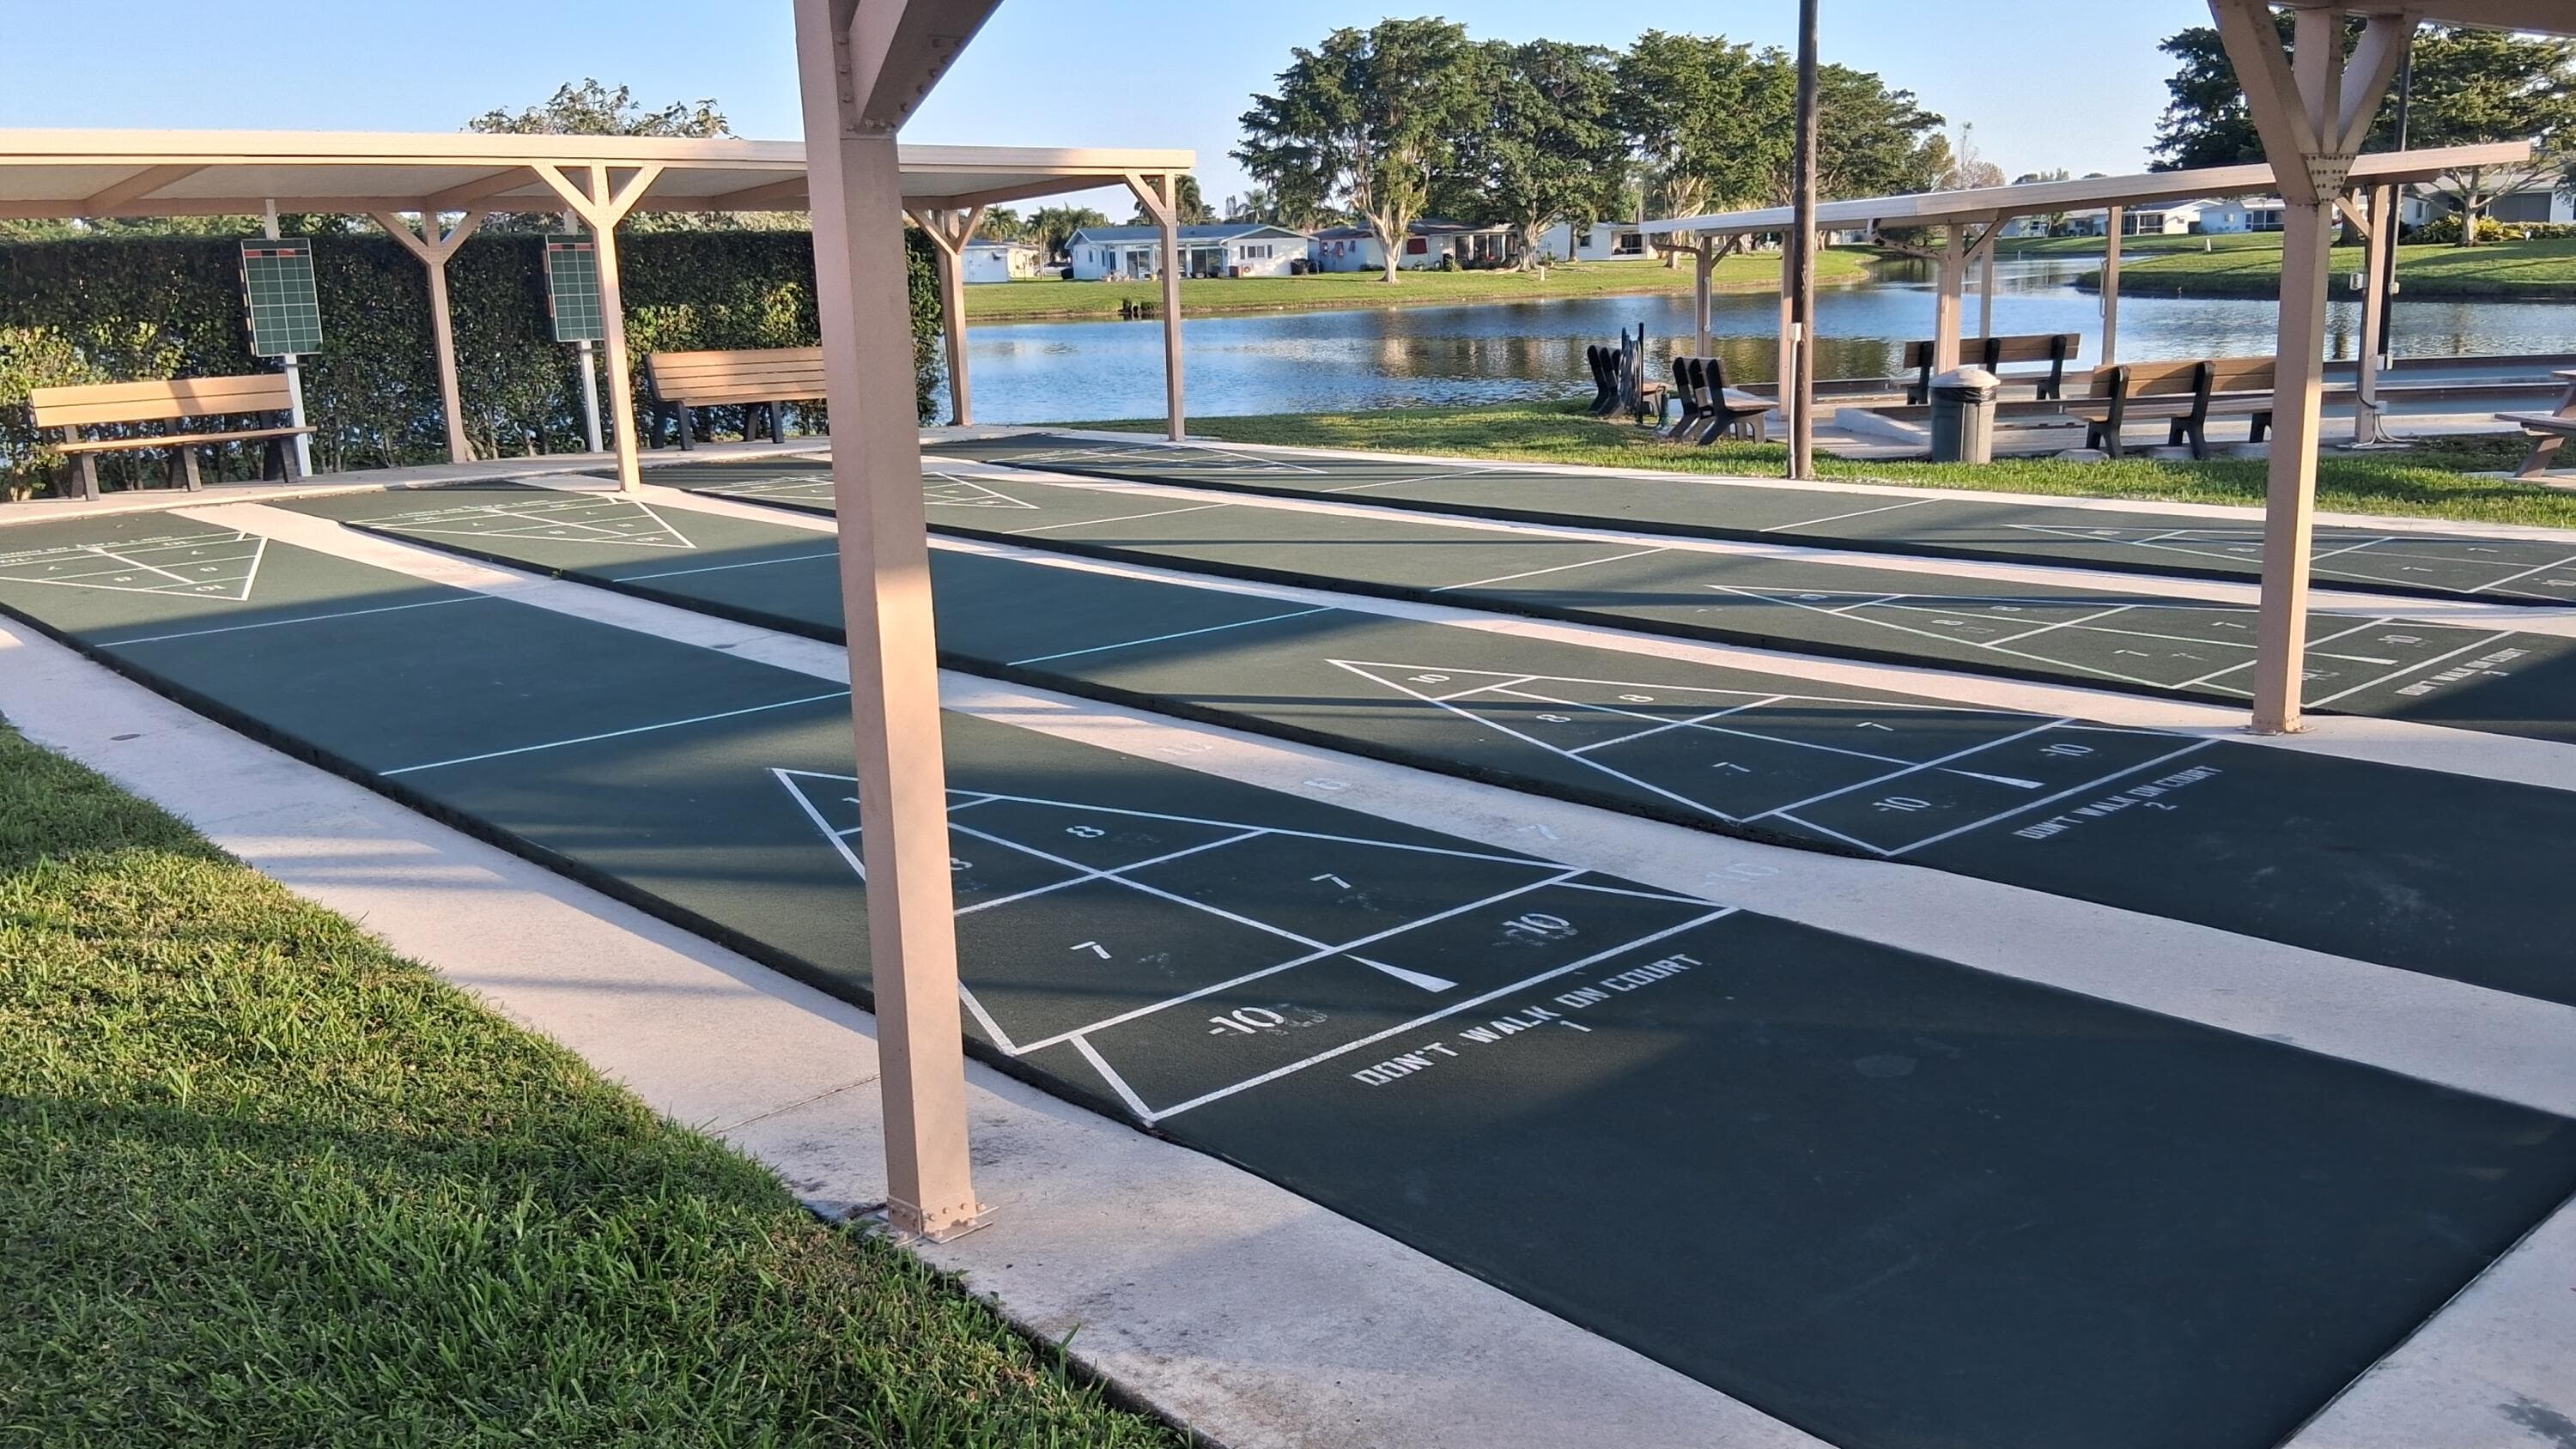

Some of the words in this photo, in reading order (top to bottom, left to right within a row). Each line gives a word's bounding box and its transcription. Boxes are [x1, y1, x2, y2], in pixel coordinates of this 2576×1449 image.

[1407, 674, 1450, 684] 10
[1619, 694, 1655, 703] 8
[1535, 714, 1571, 723] 8
[1855, 722, 1894, 731] 7
[1712, 761, 1752, 773] 7
[2011, 815, 2084, 840] DON'T
[2070, 795, 2141, 816] WALK
[2125, 785, 2170, 797] ON
[2152, 766, 2223, 788] COURT
[2143, 801, 2178, 810] 2
[1066, 825, 1106, 839] 8
[1310, 872, 1352, 889] 7
[1069, 941, 1113, 961] 7
[1208, 1005, 1285, 1035] -10
[1352, 1040, 1459, 1086] DON'T
[1459, 1005, 1561, 1044] WALK
[1554, 983, 1614, 1009] ON
[1599, 952, 1704, 992] COURT
[1560, 1019, 1593, 1032] 1
